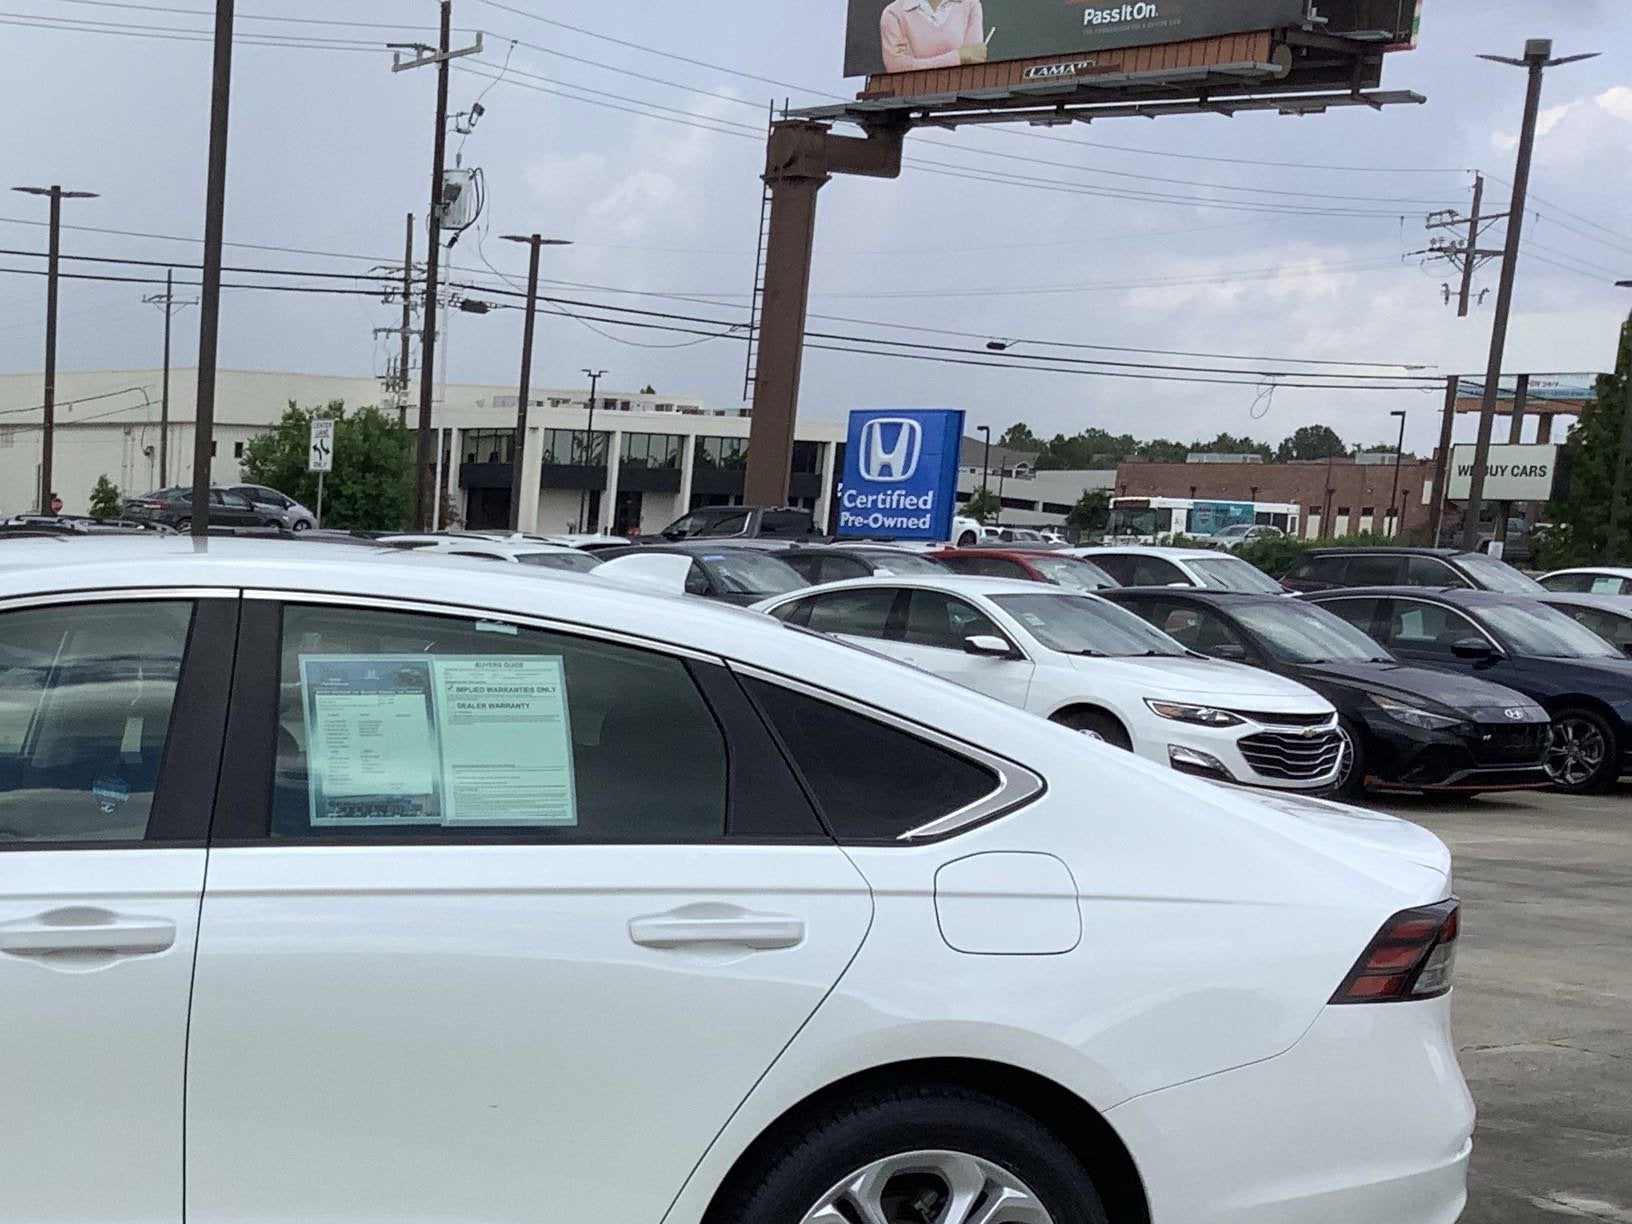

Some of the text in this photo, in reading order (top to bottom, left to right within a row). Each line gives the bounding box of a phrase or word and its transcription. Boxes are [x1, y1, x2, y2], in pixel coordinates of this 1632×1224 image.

[1511, 465, 1547, 477] CARS
[843, 489, 934, 510] Certified
[840, 511, 931, 529] Pre-Owned
